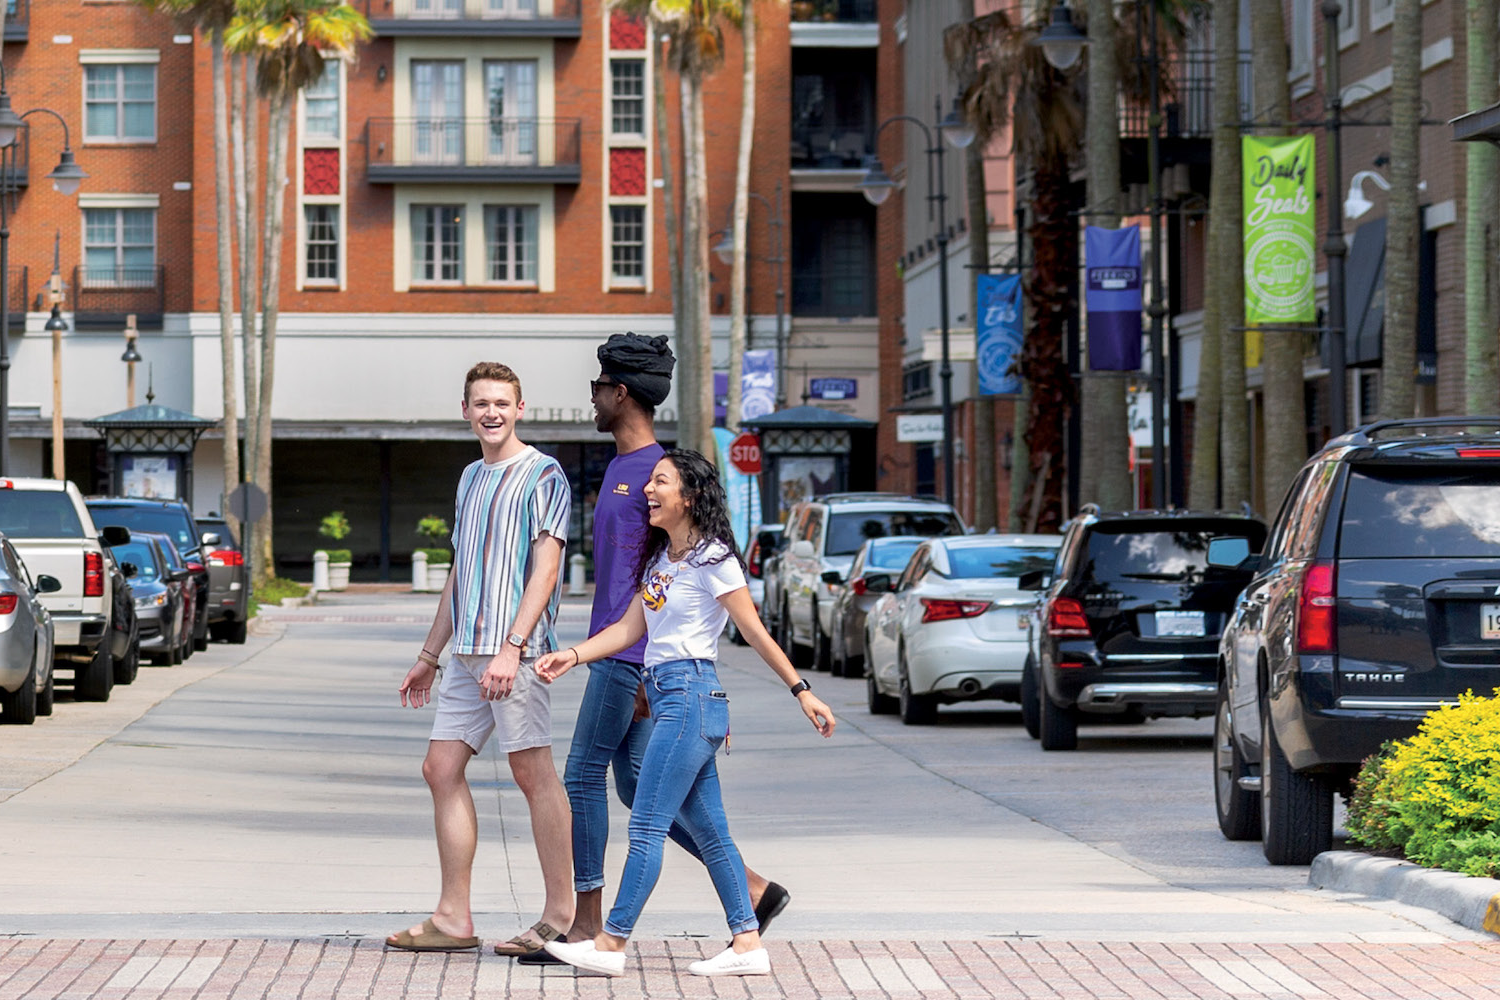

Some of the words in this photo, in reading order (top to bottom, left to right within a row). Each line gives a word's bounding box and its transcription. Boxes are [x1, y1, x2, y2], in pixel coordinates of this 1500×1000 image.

[1251, 155, 1307, 187] Daily
[732, 445, 760, 461] STO
[1345, 673, 1405, 683] TAHOE
